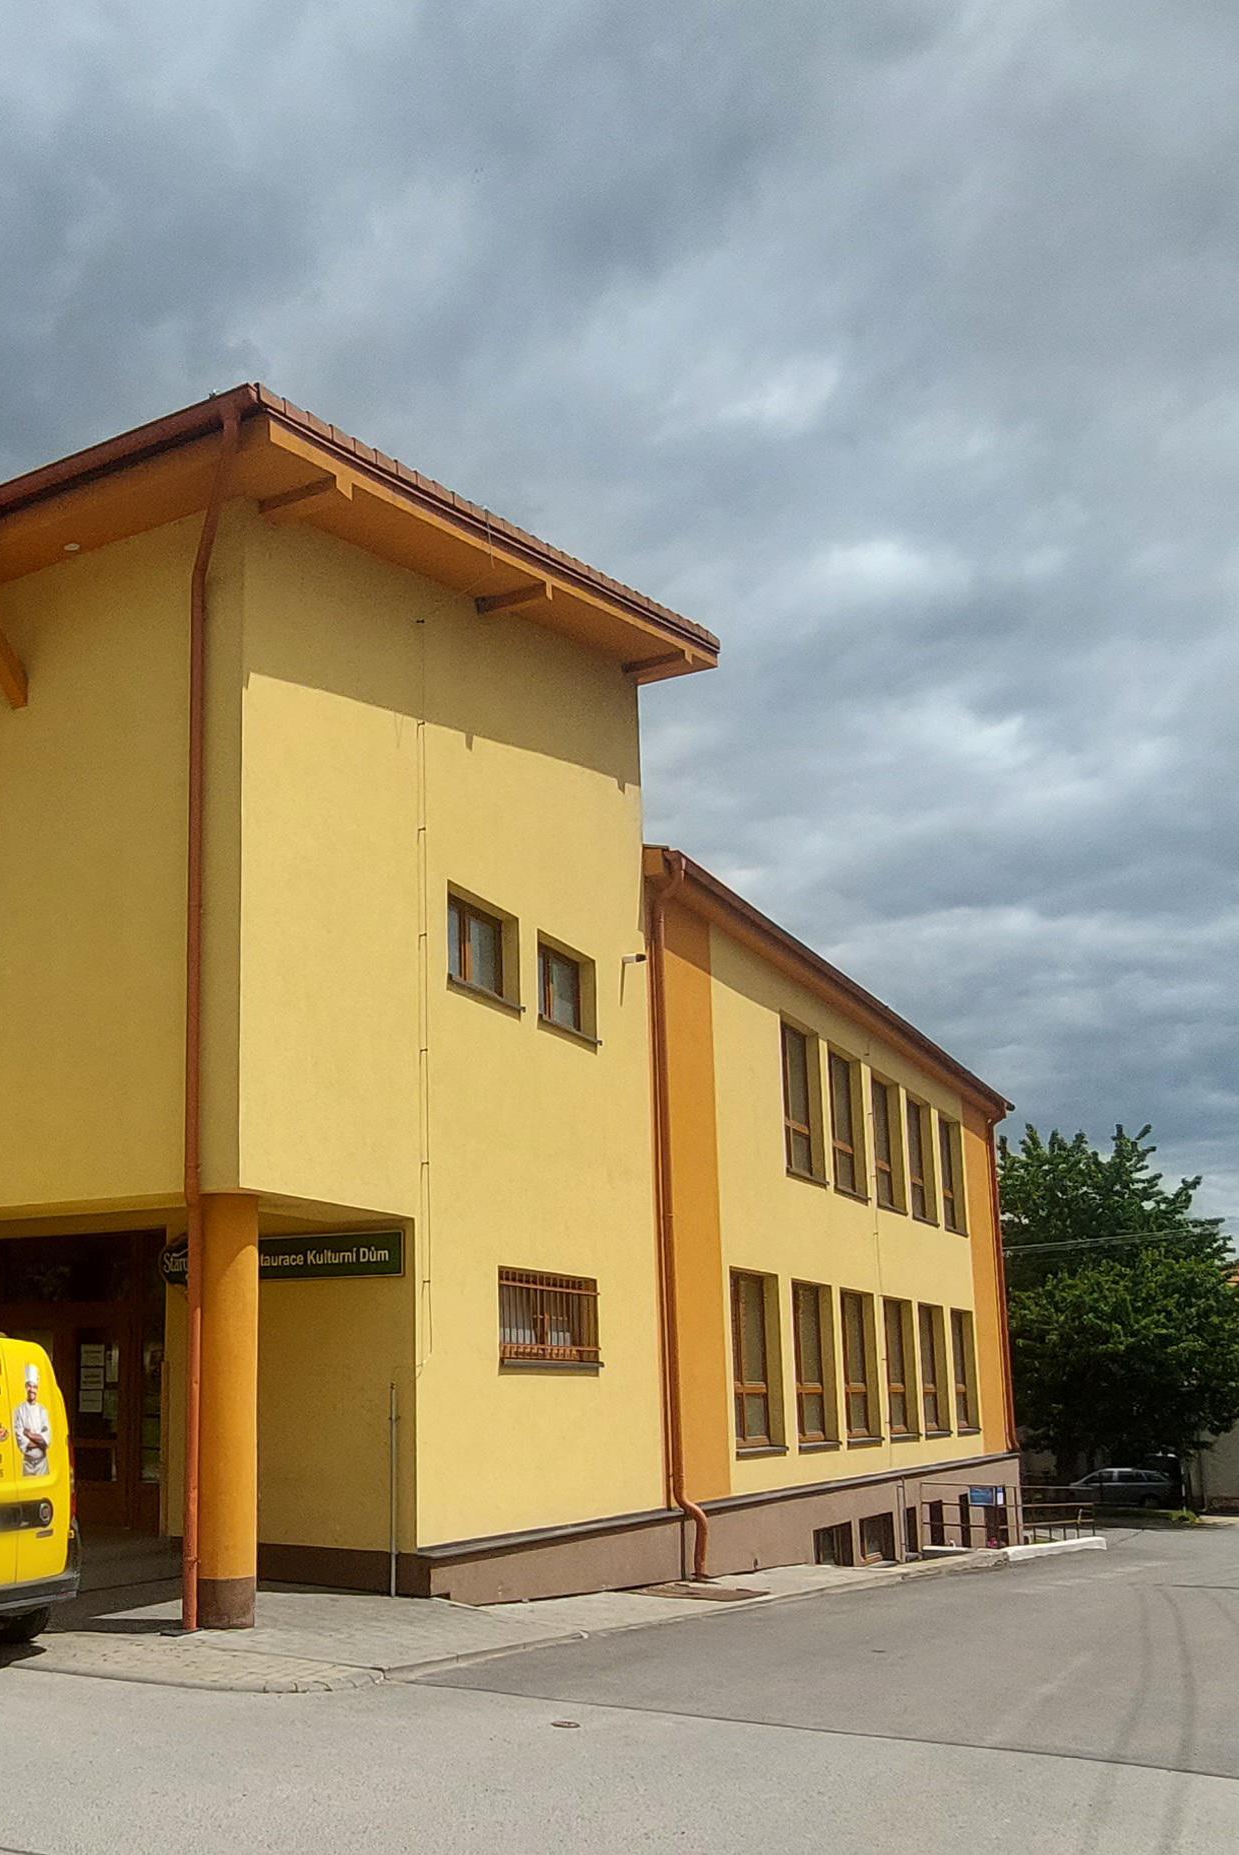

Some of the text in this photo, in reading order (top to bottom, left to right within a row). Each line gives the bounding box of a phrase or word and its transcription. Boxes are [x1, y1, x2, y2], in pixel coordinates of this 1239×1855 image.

[261, 1246, 389, 1267] taurace Kulturní Dům
